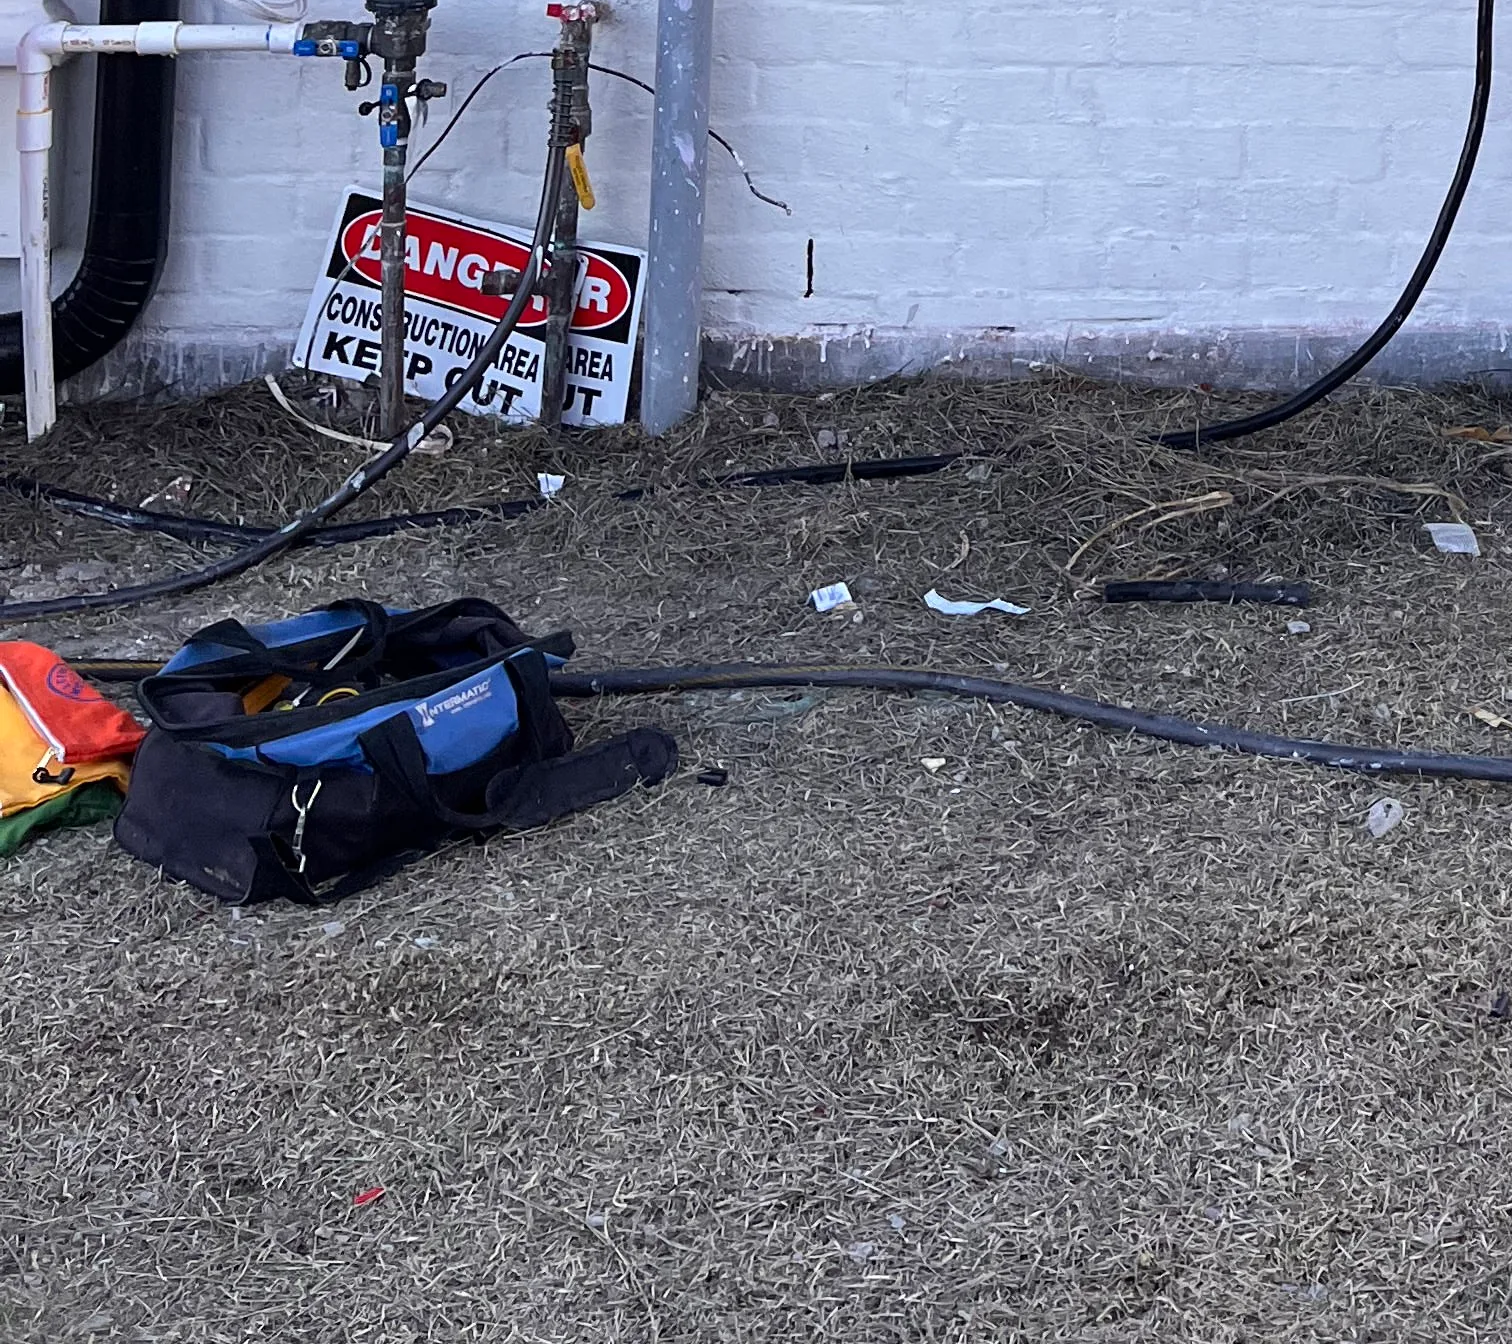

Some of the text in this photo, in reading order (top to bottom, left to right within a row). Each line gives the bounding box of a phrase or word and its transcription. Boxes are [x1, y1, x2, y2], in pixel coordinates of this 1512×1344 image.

[322, 331, 433, 381] KEP
[327, 293, 540, 383] CONSRUCTION REA
